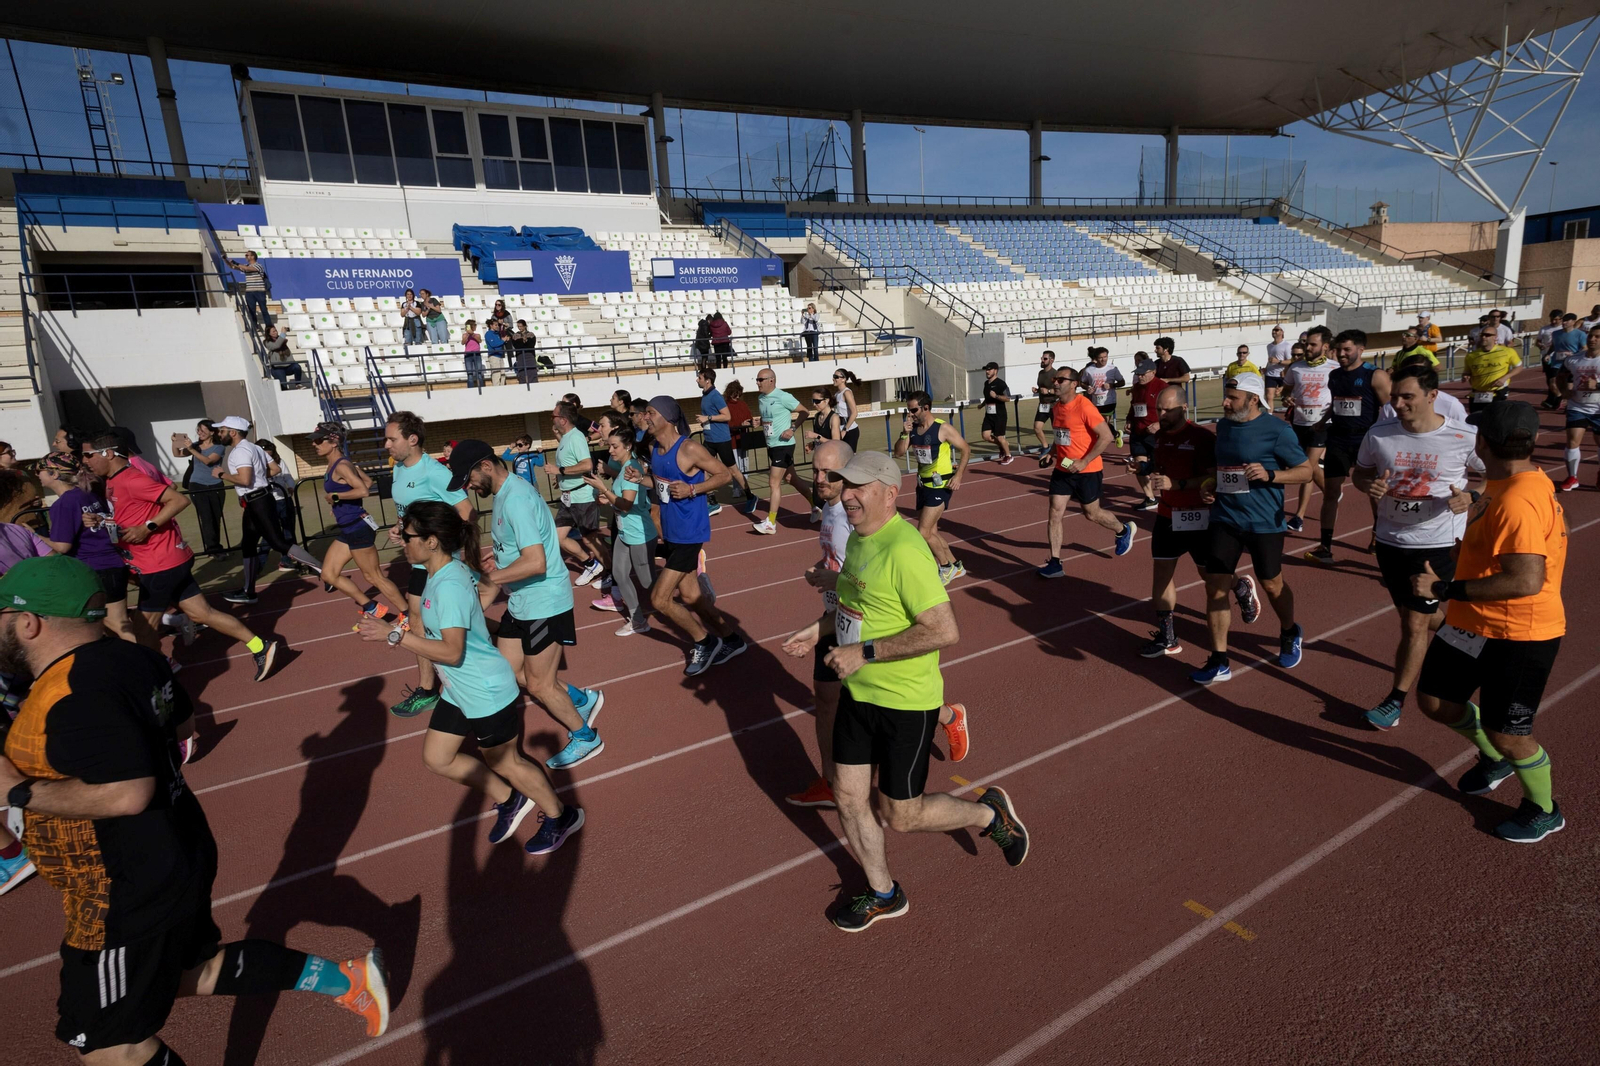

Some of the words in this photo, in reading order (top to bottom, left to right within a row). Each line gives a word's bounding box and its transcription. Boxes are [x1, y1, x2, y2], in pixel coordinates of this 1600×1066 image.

[324, 269, 349, 278] SAN
[351, 268, 413, 278] FERNANDO
[679, 267, 696, 275] SAN
[696, 266, 738, 275] FERNANDO
[326, 280, 355, 290] CLUB
[355, 279, 415, 290] DEPORTIVO
[679, 276, 699, 284] CLUB
[699, 275, 739, 284] DEPORTIVO
[1340, 401, 1355, 409] 120
[1396, 451, 1438, 461] XXXVI
[1222, 473, 1239, 484] 588
[1393, 500, 1420, 513] 734
[1180, 511, 1202, 522] 589
[837, 612, 852, 634] 557
